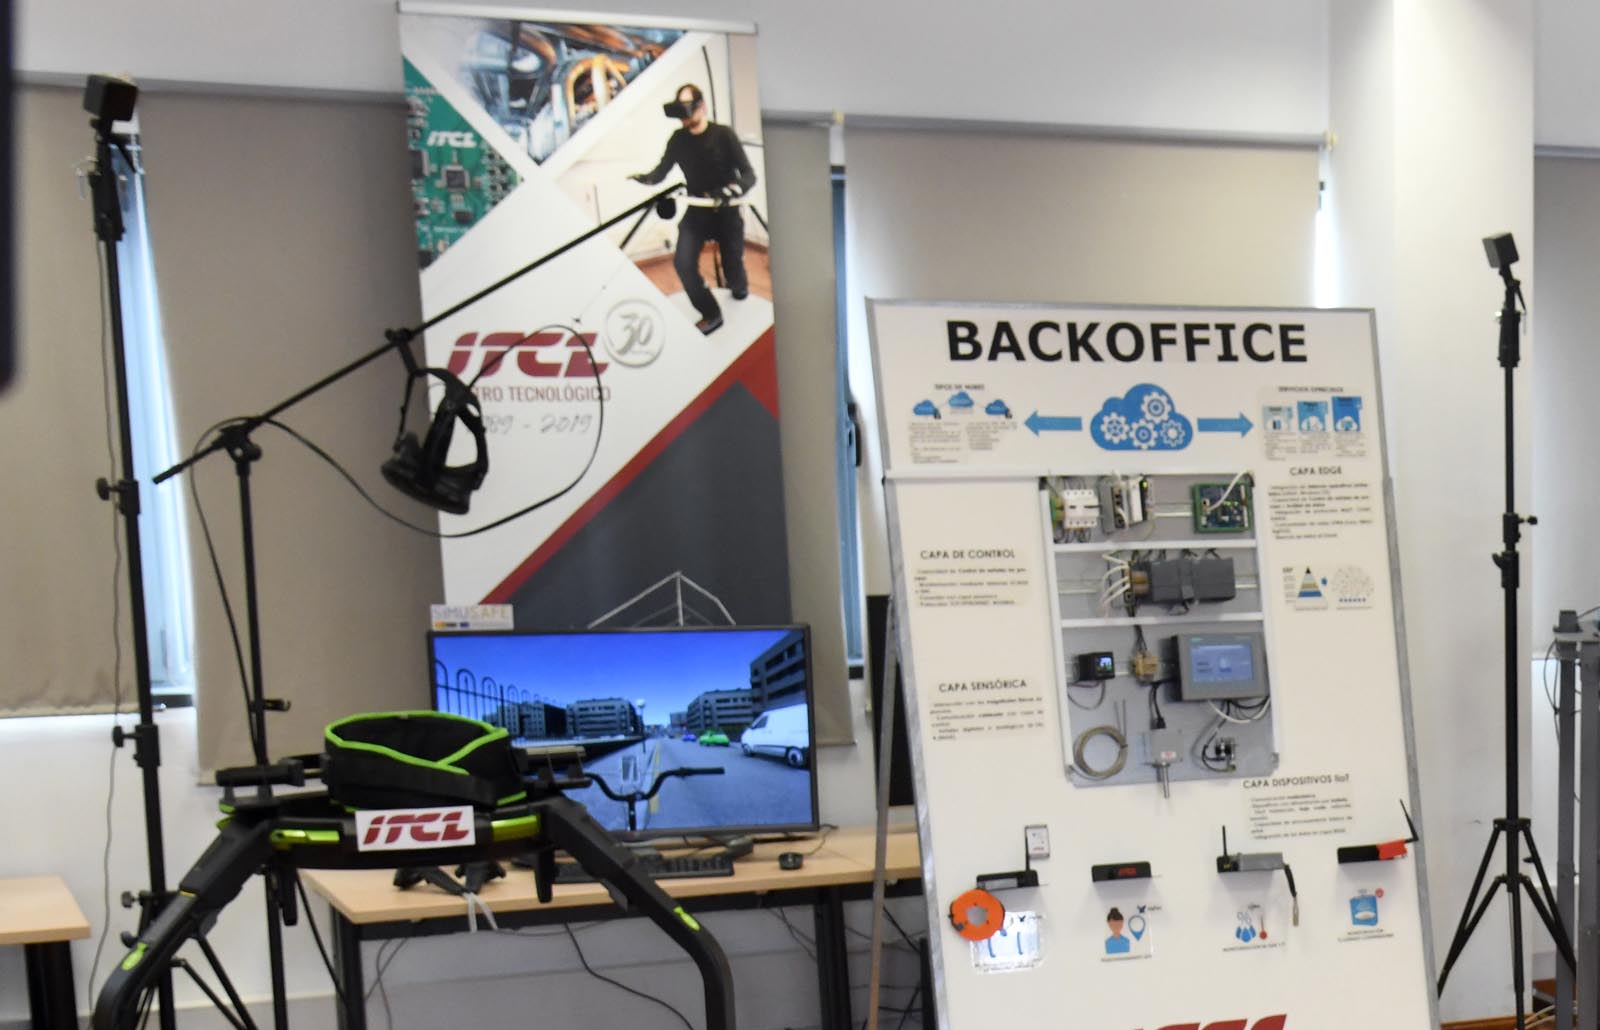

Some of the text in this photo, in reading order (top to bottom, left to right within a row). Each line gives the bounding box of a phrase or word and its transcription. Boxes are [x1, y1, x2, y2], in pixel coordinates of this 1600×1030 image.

[427, 131, 477, 148] ITCL
[617, 312, 653, 355] 30
[946, 320, 1308, 363] BACKOFFICE
[447, 331, 609, 378] ITCL
[509, 384, 612, 401] TECNOLÓGICO
[540, 413, 593, 434] 2019
[1289, 465, 1342, 476] CAPA EDGE
[920, 549, 1015, 560] CAPA DE CONTROL
[938, 678, 1027, 693] CAPA SENSÓRICA
[1242, 779, 1269, 789] CAPA
[1272, 775, 1332, 787] DISPOSITIVOS
[363, 811, 470, 845] ITCL
